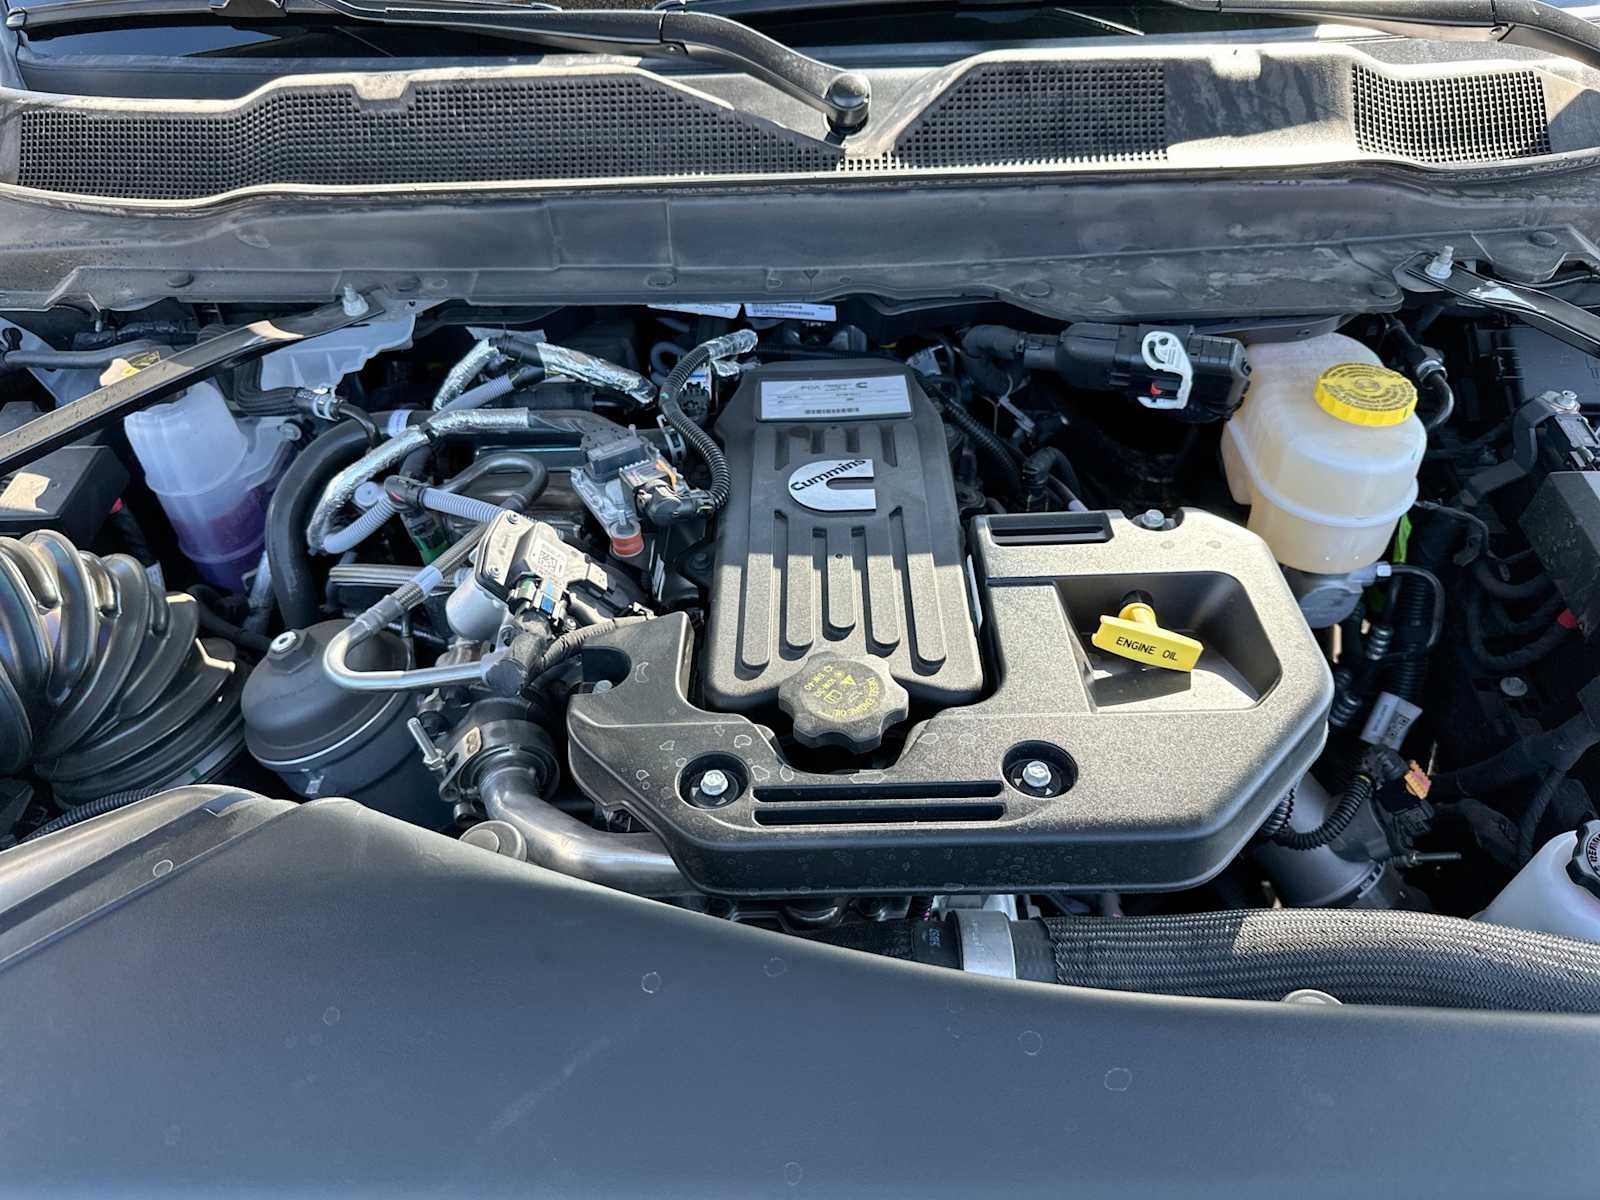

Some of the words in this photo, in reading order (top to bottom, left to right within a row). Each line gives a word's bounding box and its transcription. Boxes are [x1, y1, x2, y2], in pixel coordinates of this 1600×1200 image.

[790, 458, 866, 492] Cummins
[1115, 635, 1157, 655] ENGINE
[1162, 649, 1178, 661] OIL
[832, 708, 846, 717] OIL
[848, 698, 873, 716] ENGINE
